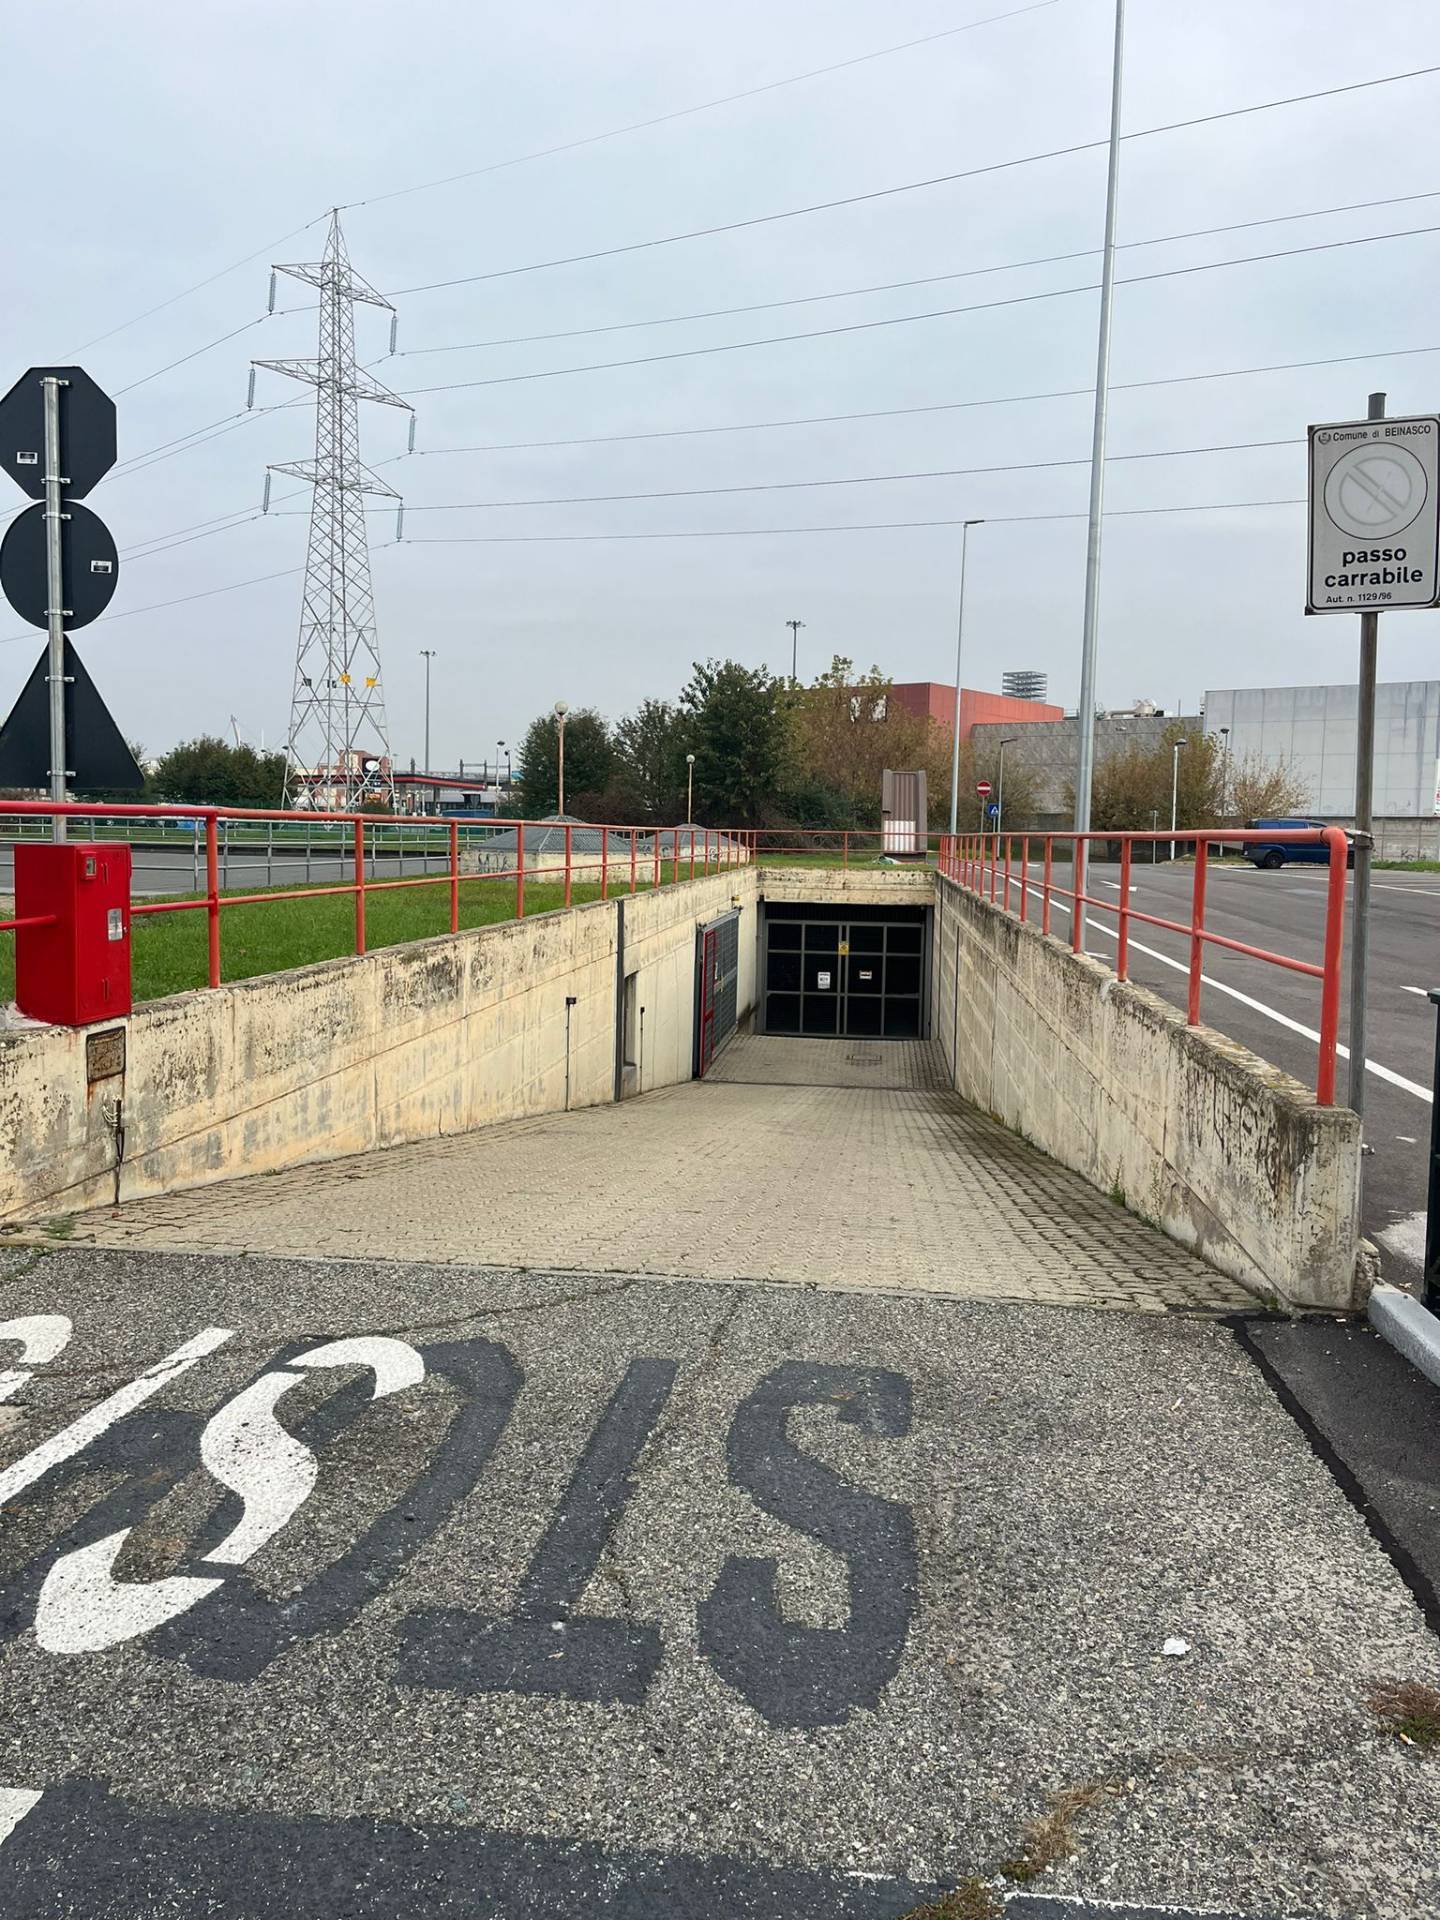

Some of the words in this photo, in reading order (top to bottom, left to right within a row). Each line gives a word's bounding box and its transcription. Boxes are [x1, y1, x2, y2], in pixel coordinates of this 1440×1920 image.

[1333, 431, 1368, 441] Comune
[1385, 425, 1431, 437] BEINASCO
[1342, 548, 1407, 568] passo
[1324, 566, 1423, 588] carrabile
